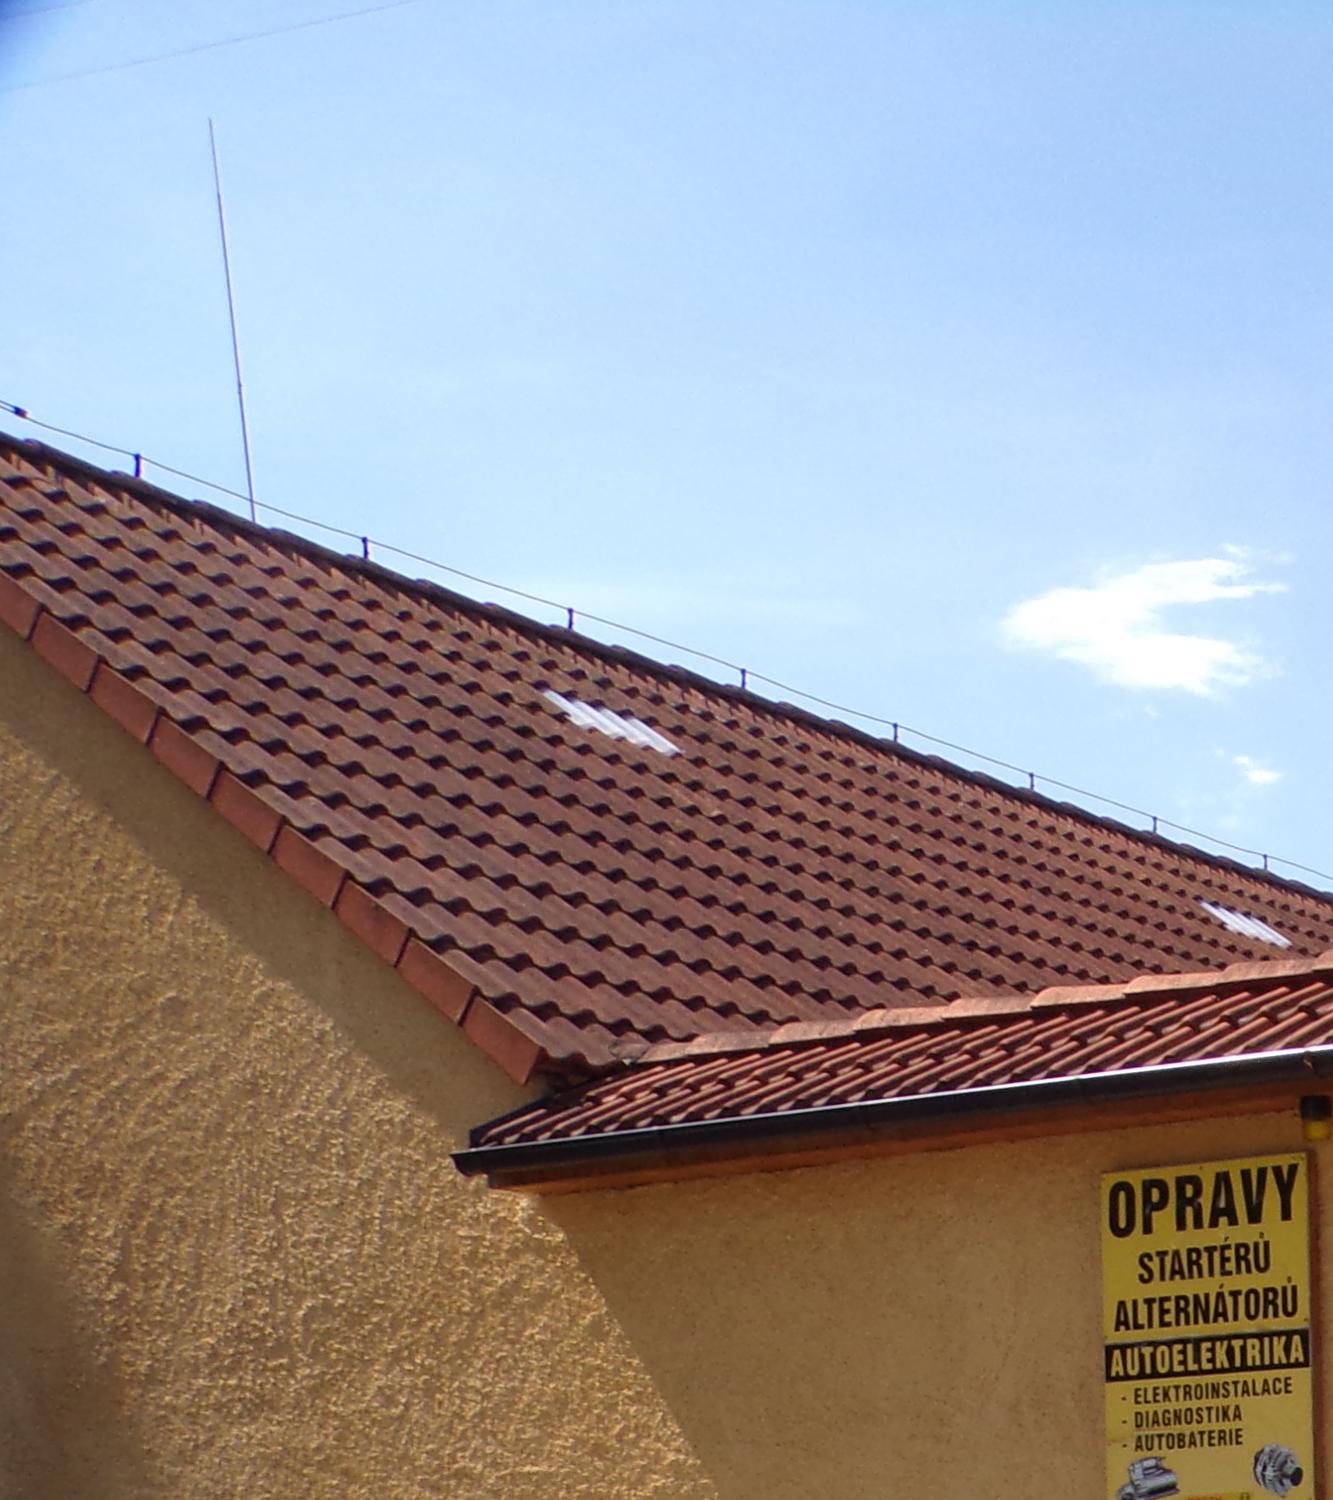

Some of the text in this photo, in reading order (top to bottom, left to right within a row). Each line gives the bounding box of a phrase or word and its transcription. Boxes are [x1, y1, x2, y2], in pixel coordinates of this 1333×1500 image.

[1108, 1163, 1299, 1238] OPRAVY
[1138, 1231, 1271, 1284] STARTÉRŮ
[1114, 1276, 1299, 1332] ALTERNÁTORŮ
[1110, 1335, 1304, 1378] AUTOELEKTRIKA
[1134, 1377, 1293, 1405] ELEKTROINSTALACE
[1134, 1405, 1242, 1428] DIAGNOSTIKA
[1134, 1428, 1243, 1452] AUTOBATERIE
